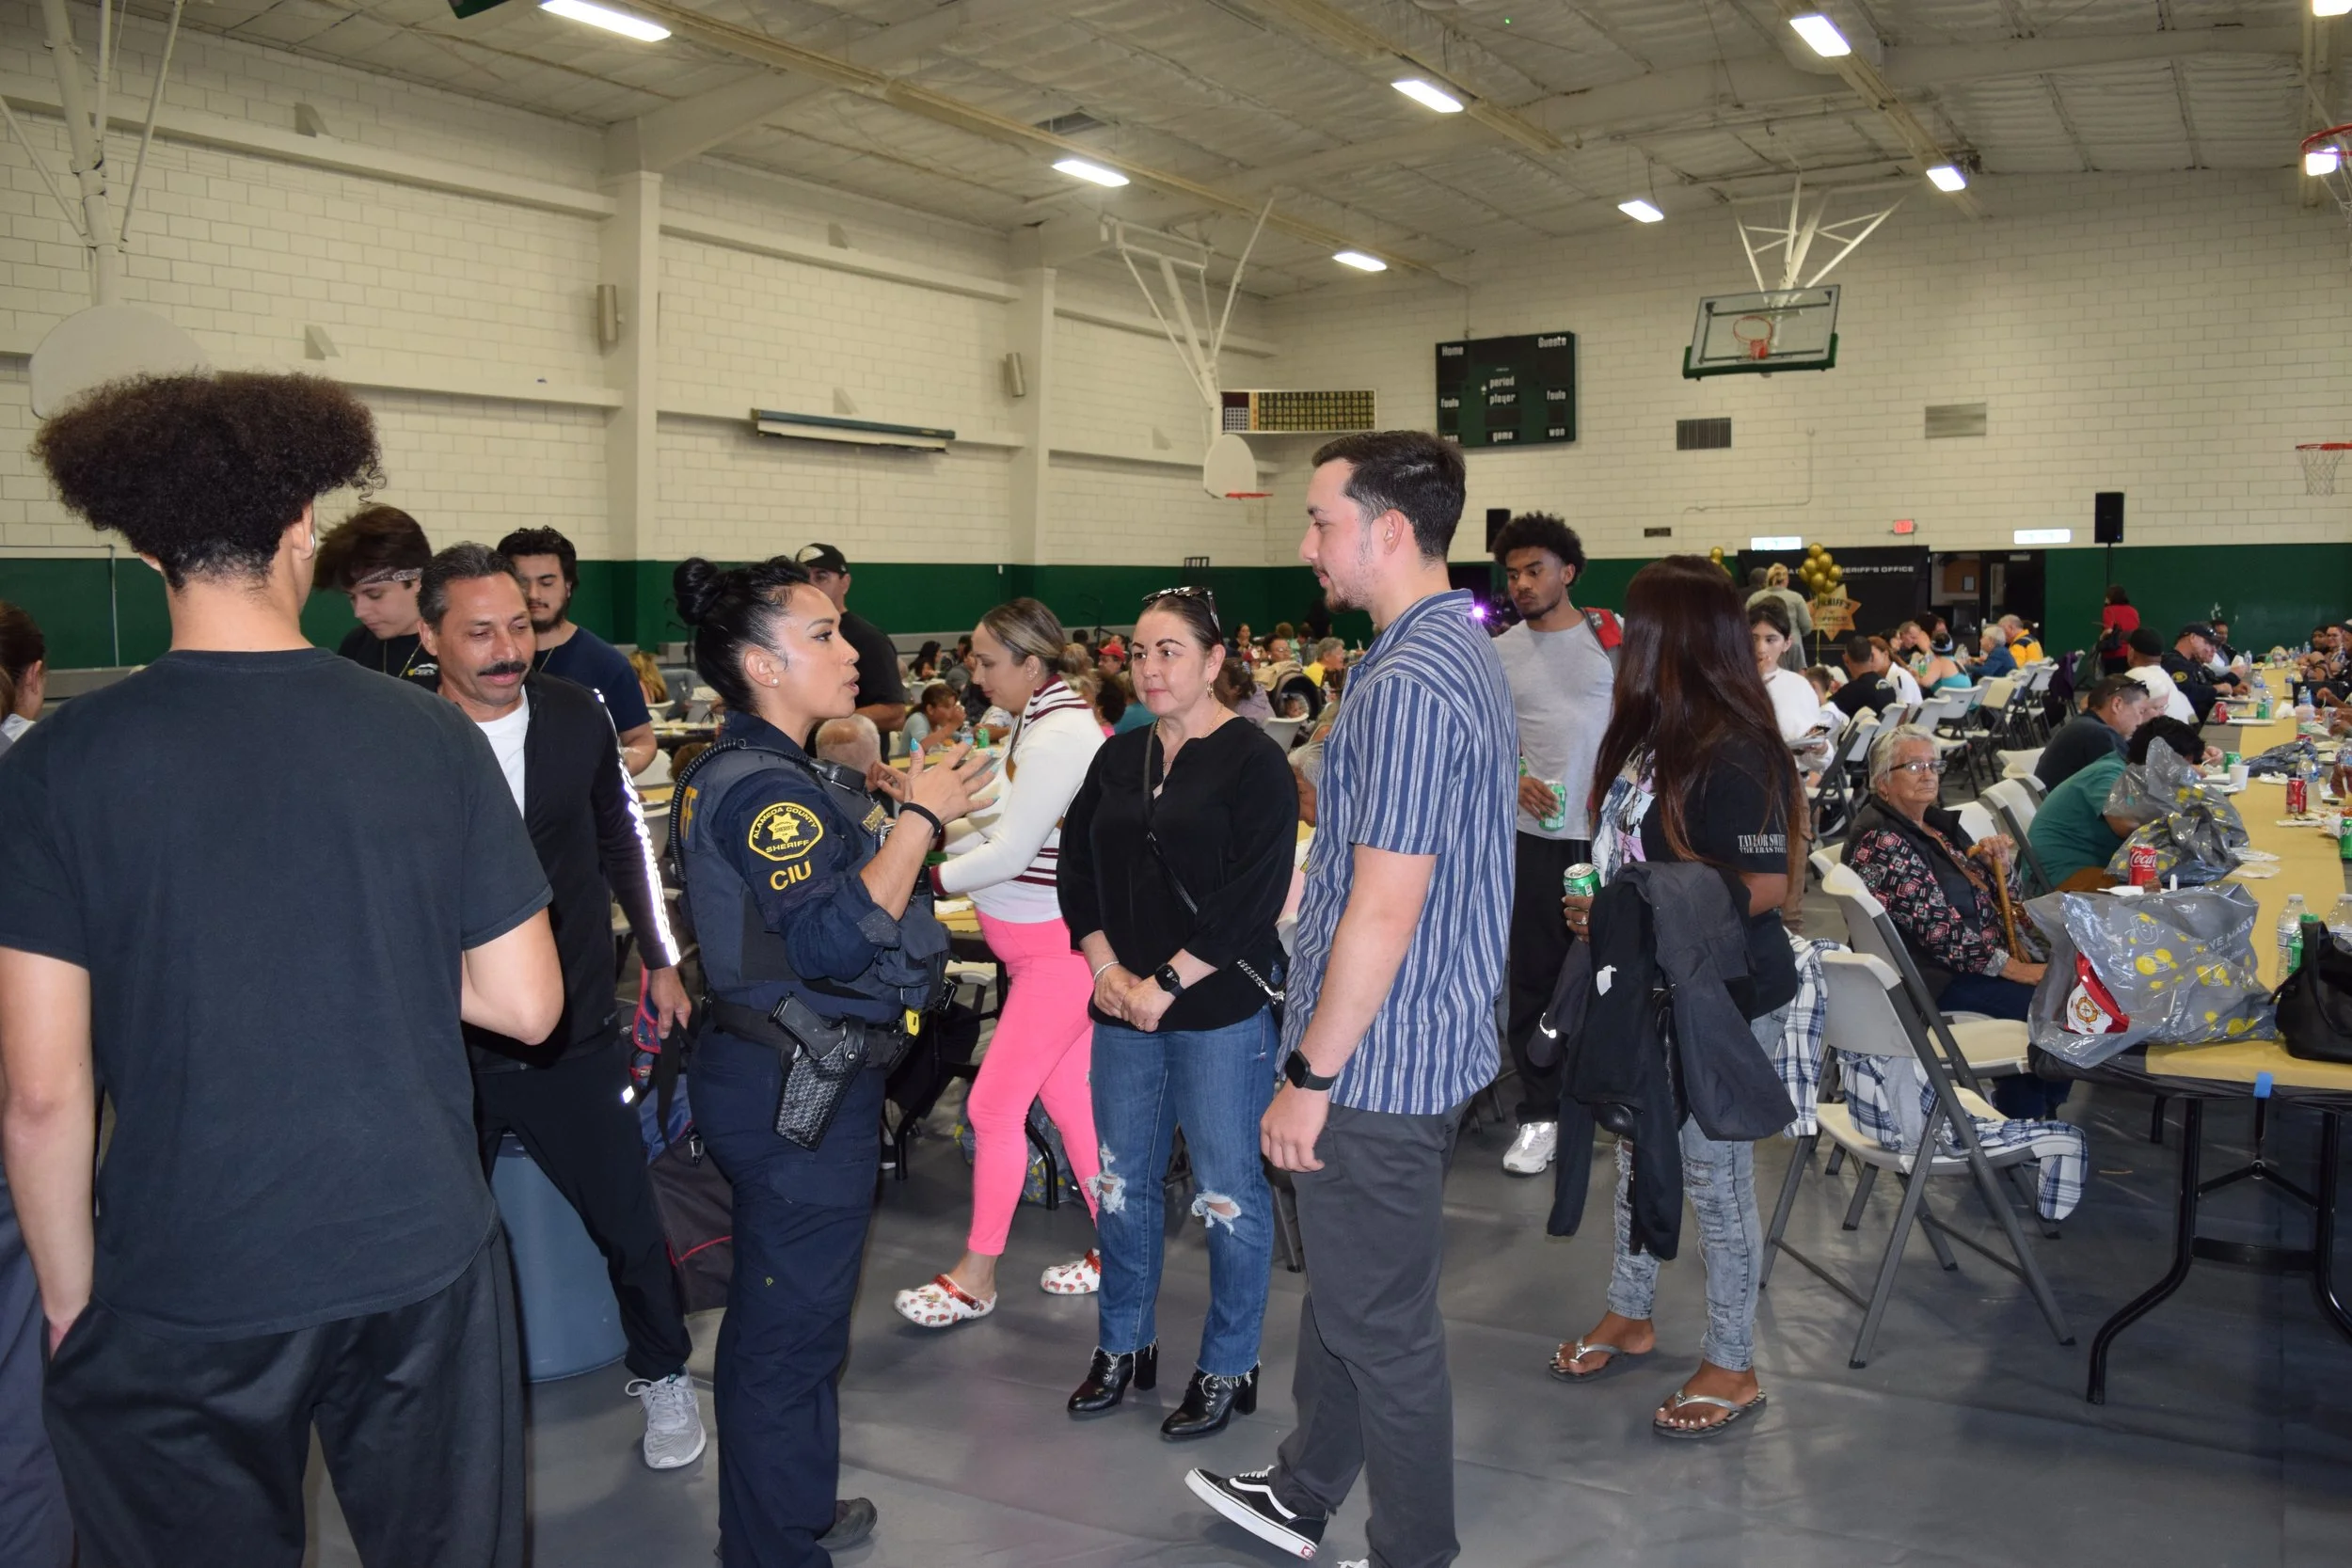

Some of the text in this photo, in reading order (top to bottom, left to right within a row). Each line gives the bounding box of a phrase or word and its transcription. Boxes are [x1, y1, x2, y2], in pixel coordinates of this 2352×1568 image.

[1538, 337, 1566, 348] Guests
[1442, 346, 1464, 356] Home
[1489, 376, 1515, 388] period
[1489, 393, 1516, 404] player
[1547, 390, 1565, 401] fouls
[1440, 398, 1459, 408] fouls
[1492, 431, 1513, 442] game
[1549, 427, 1565, 436] won
[754, 806, 817, 839] ALAMEDA COUNTY
[766, 839, 810, 853] SHERIFF
[1738, 834, 1768, 847] TAYLOR
[770, 861, 812, 891] CIU
